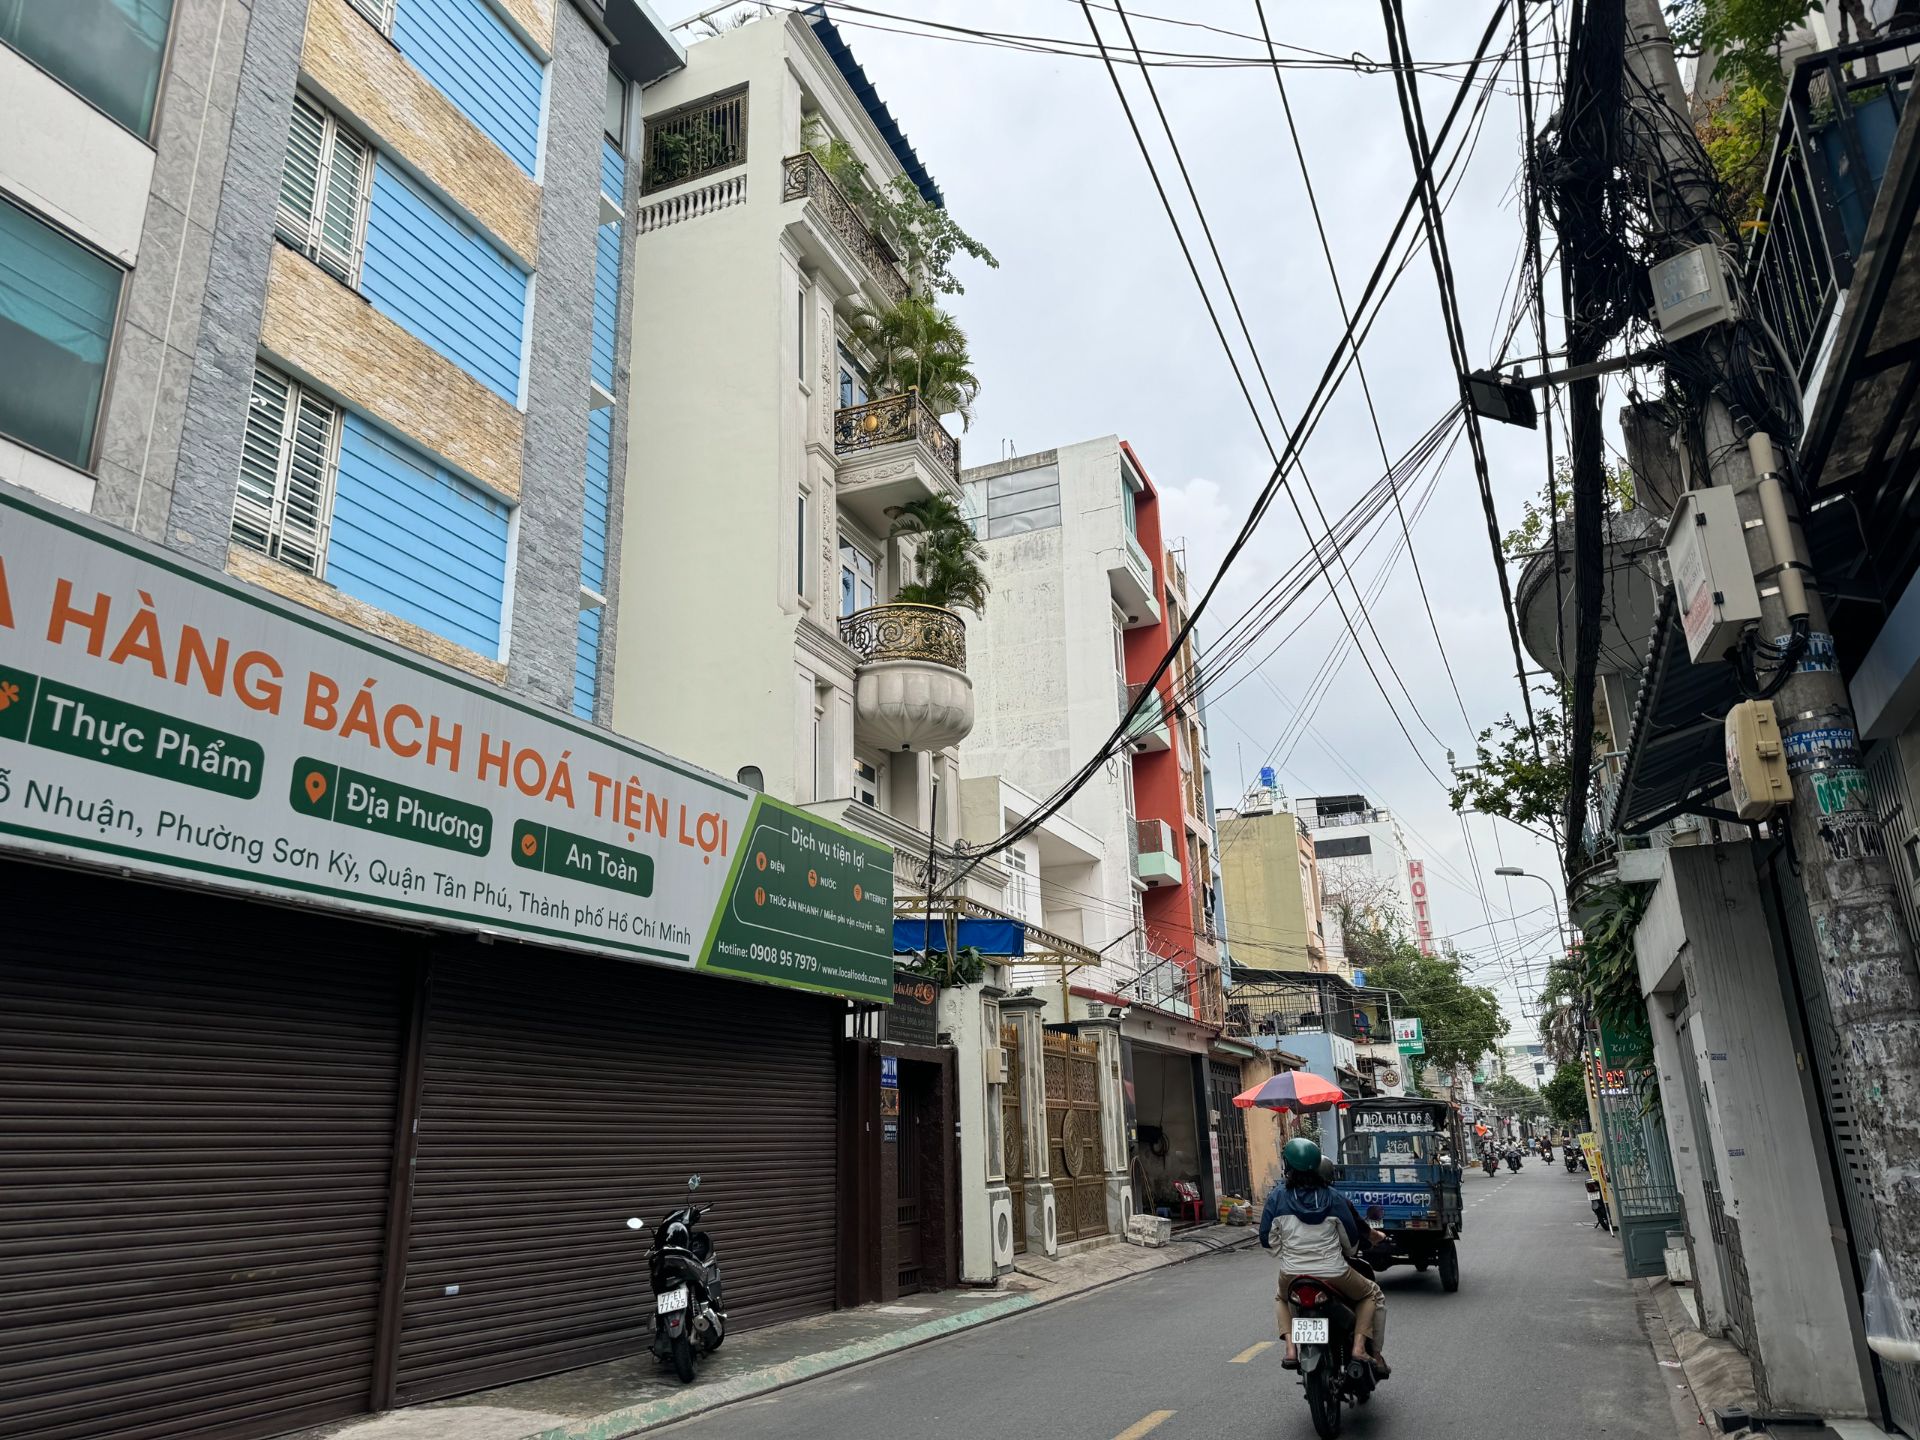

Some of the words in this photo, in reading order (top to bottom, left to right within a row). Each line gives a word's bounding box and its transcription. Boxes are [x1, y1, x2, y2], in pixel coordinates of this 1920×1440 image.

[45, 694, 144, 756] Thực
[155, 727, 251, 783] Phẩm
[46, 578, 284, 715] HÀNG
[303, 671, 462, 773] BÁCH
[477, 733, 575, 810] HOÁ
[588, 770, 669, 843] TIỆN
[678, 804, 728, 865] LỢI
[347, 782, 389, 824] Địa
[396, 796, 484, 849] Phương
[24, 779, 143, 837] Nhuận,
[156, 810, 264, 863] Phường
[272, 838, 319, 870] Sơn
[328, 849, 360, 883] Kỳ,
[369, 860, 425, 895] Quận
[434, 872, 466, 900] Tân
[473, 881, 512, 911] Phú,
[520, 891, 569, 920] Thành
[574, 904, 604, 927] phố
[608, 910, 628, 932] Hồ
[632, 916, 656, 936] Chí
[659, 922, 691, 945] Minh
[565, 843, 591, 871] An
[598, 850, 638, 883] Toàn
[770, 859, 785, 875] ĐIỆN
[791, 825, 815, 852] Dịch
[818, 841, 830, 861] vụ
[833, 844, 851, 866] tiện
[853, 852, 865, 872] lợi
[769, 893, 786, 906] THỨC
[787, 899, 797, 911] ĂN
[797, 902, 819, 916] NHANH
[820, 876, 837, 890] NƯỚC
[864, 891, 887, 906] INTERNET
[1409, 861, 1433, 957] HOTEL
[718, 940, 748, 958] Hotline:
[750, 943, 777, 964] 0908
[780, 951, 793, 968] 95
[794, 953, 817, 973] 7979
[822, 965, 888, 986] www.localfoods.com.vn
[1297, 1320, 1323, 1331] 59-D3
